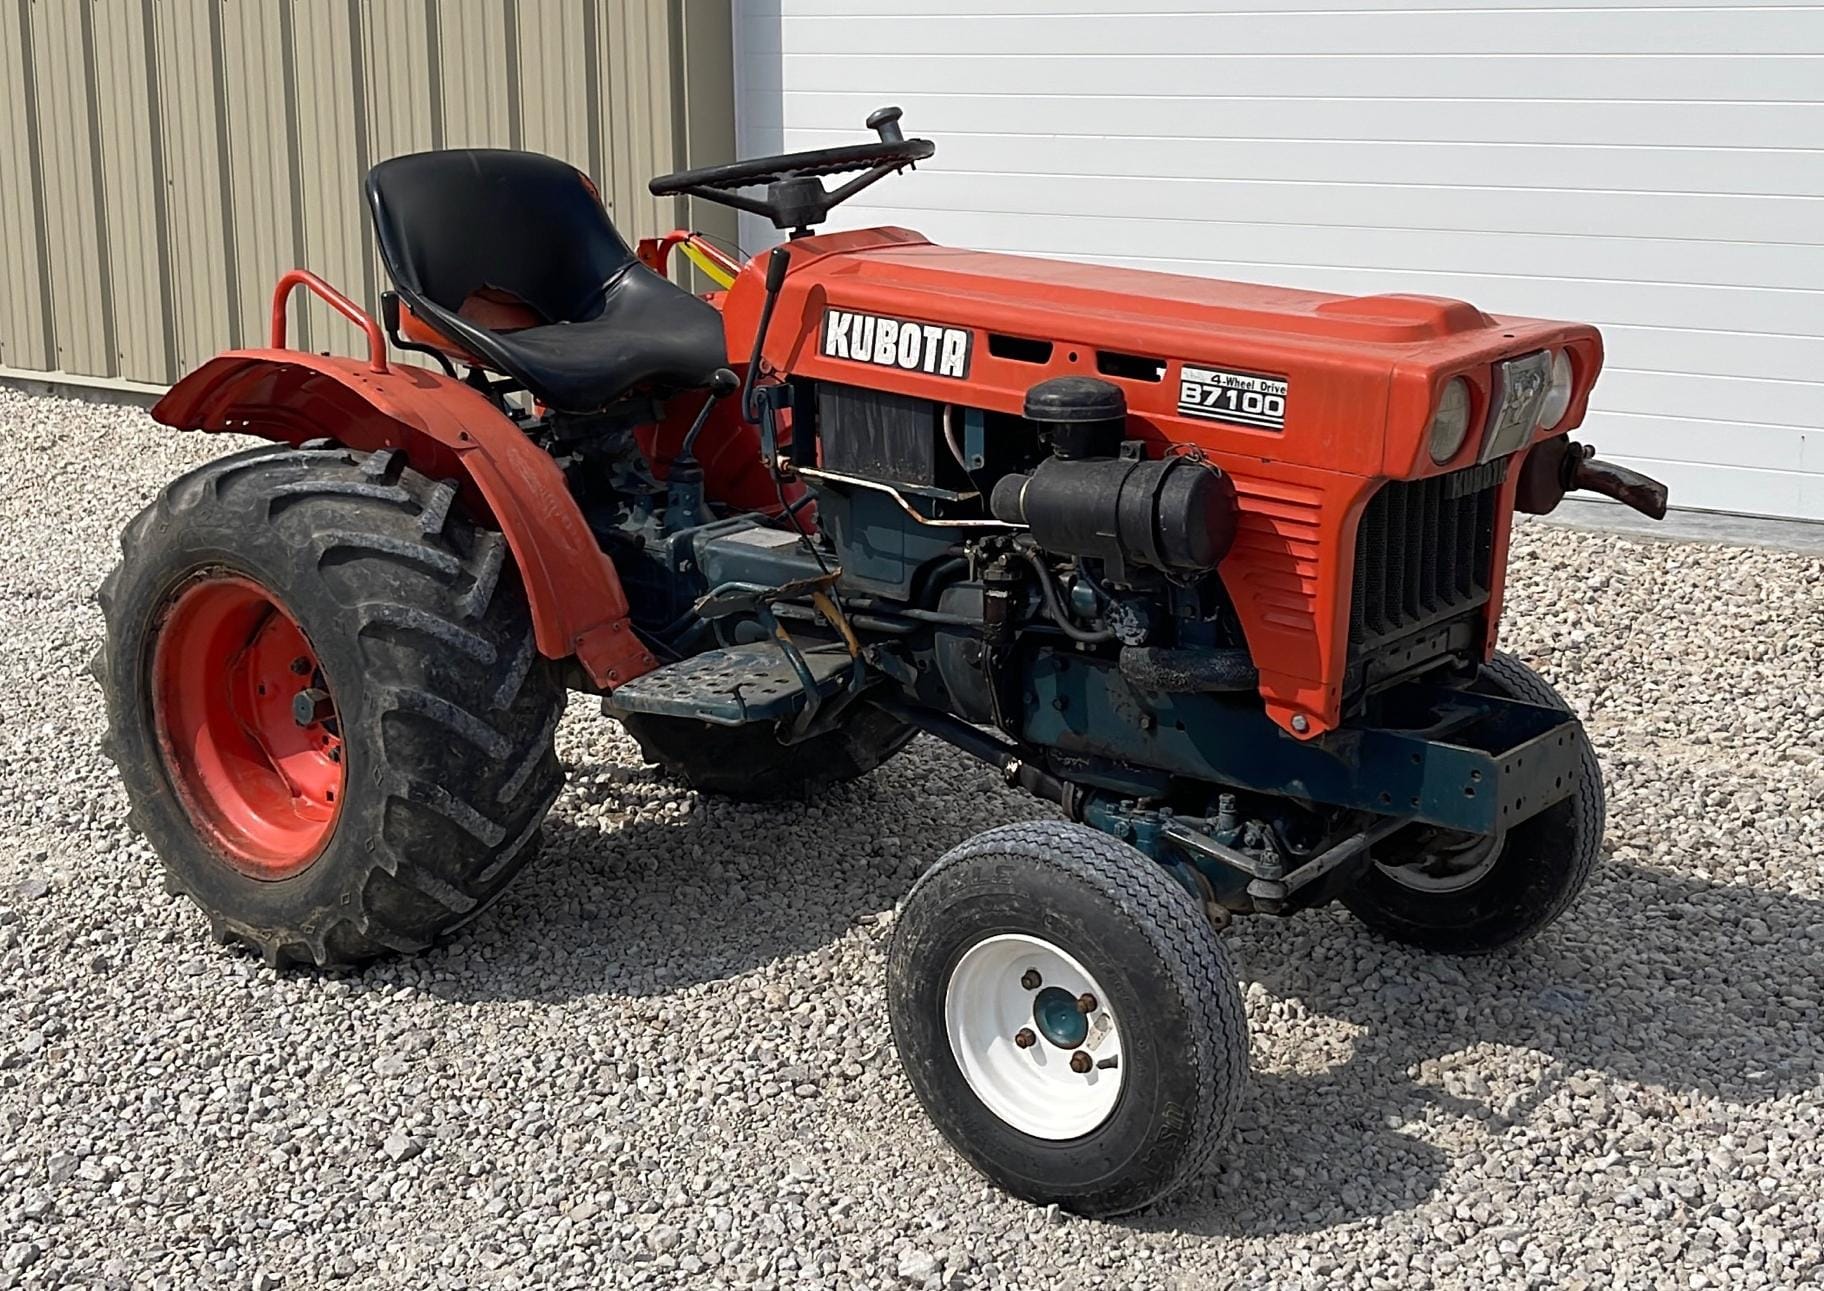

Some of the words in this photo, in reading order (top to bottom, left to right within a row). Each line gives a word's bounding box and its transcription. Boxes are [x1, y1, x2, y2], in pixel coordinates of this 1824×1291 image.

[826, 311, 967, 377] KUBOTA
[1181, 383, 1284, 417] B7100
[1211, 374, 1255, 390] 4-Wheel
[1261, 382, 1286, 394] Drive
